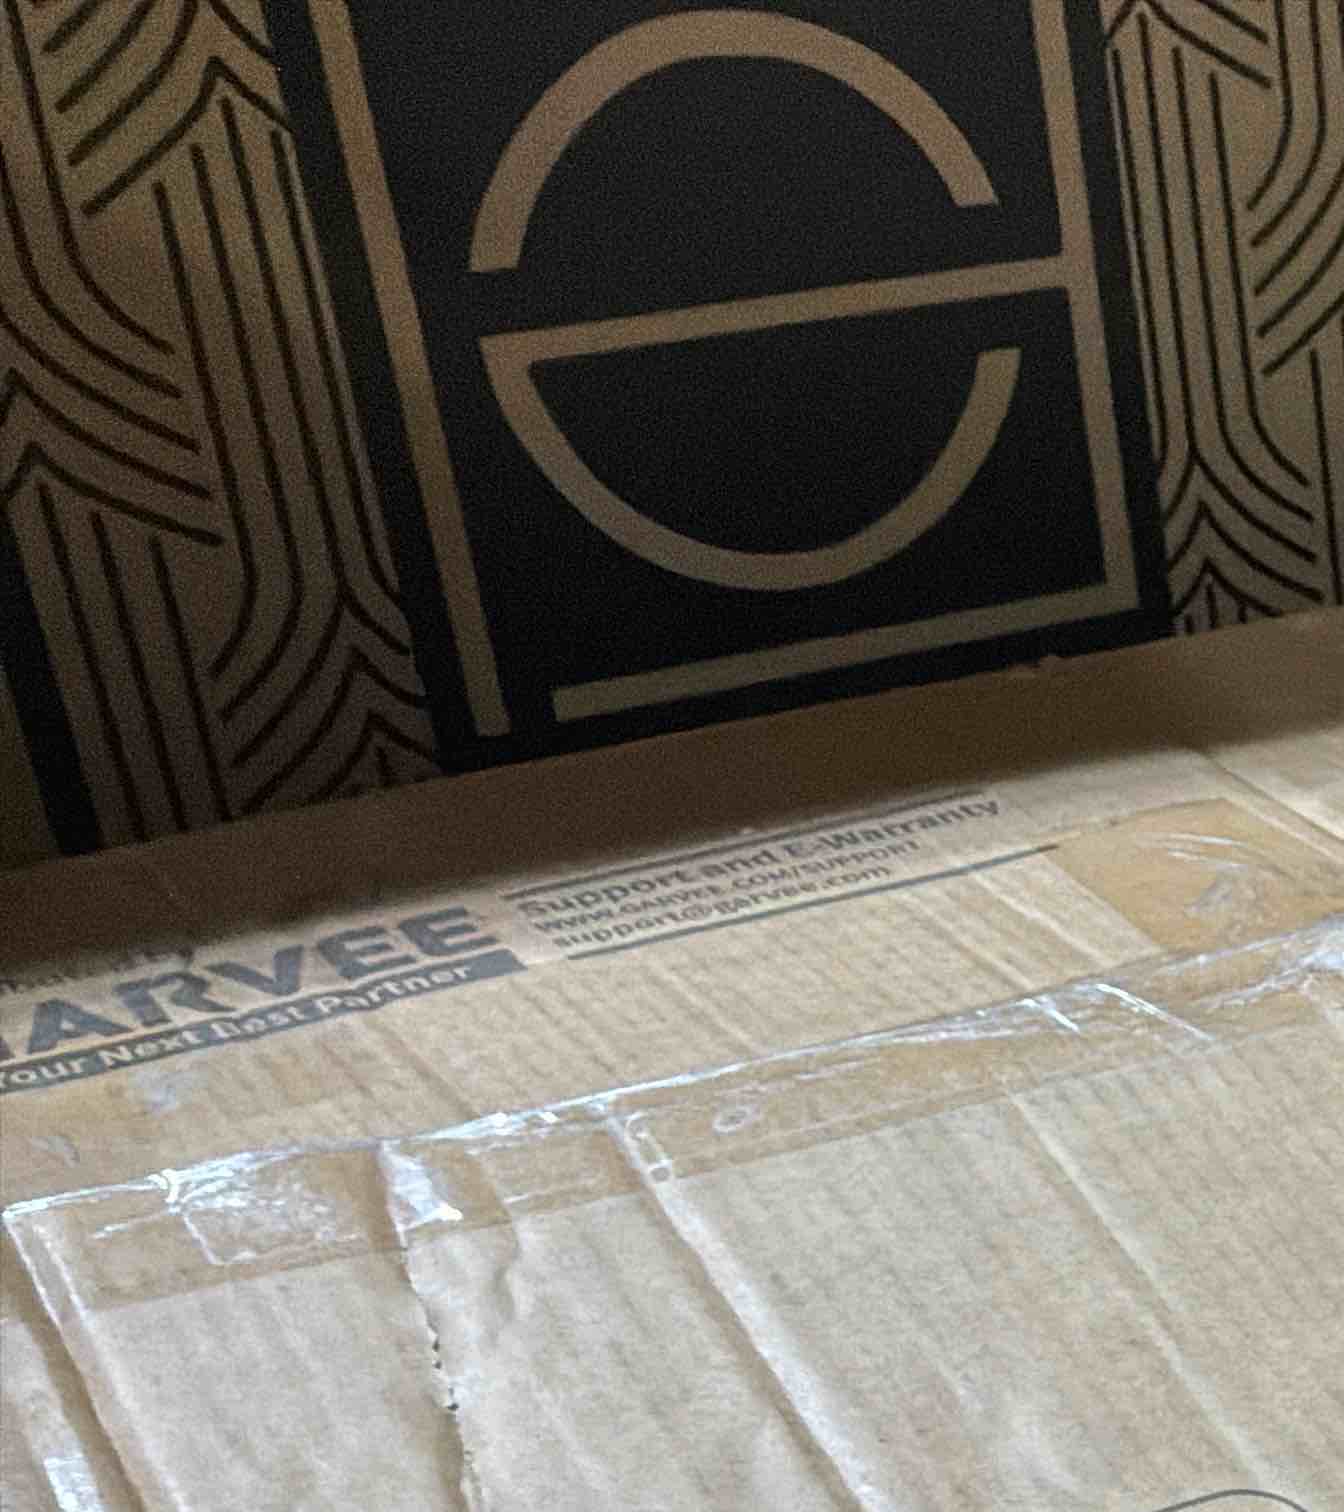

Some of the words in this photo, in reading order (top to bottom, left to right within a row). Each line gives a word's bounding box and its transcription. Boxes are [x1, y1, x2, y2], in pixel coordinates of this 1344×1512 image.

[517, 870, 688, 918] Support
[700, 846, 777, 880] and
[784, 799, 1001, 864] E-Warranty
[0, 907, 501, 1060] ARVEE
[99, 1026, 204, 1068] Next
[315, 963, 476, 1014] Partner
